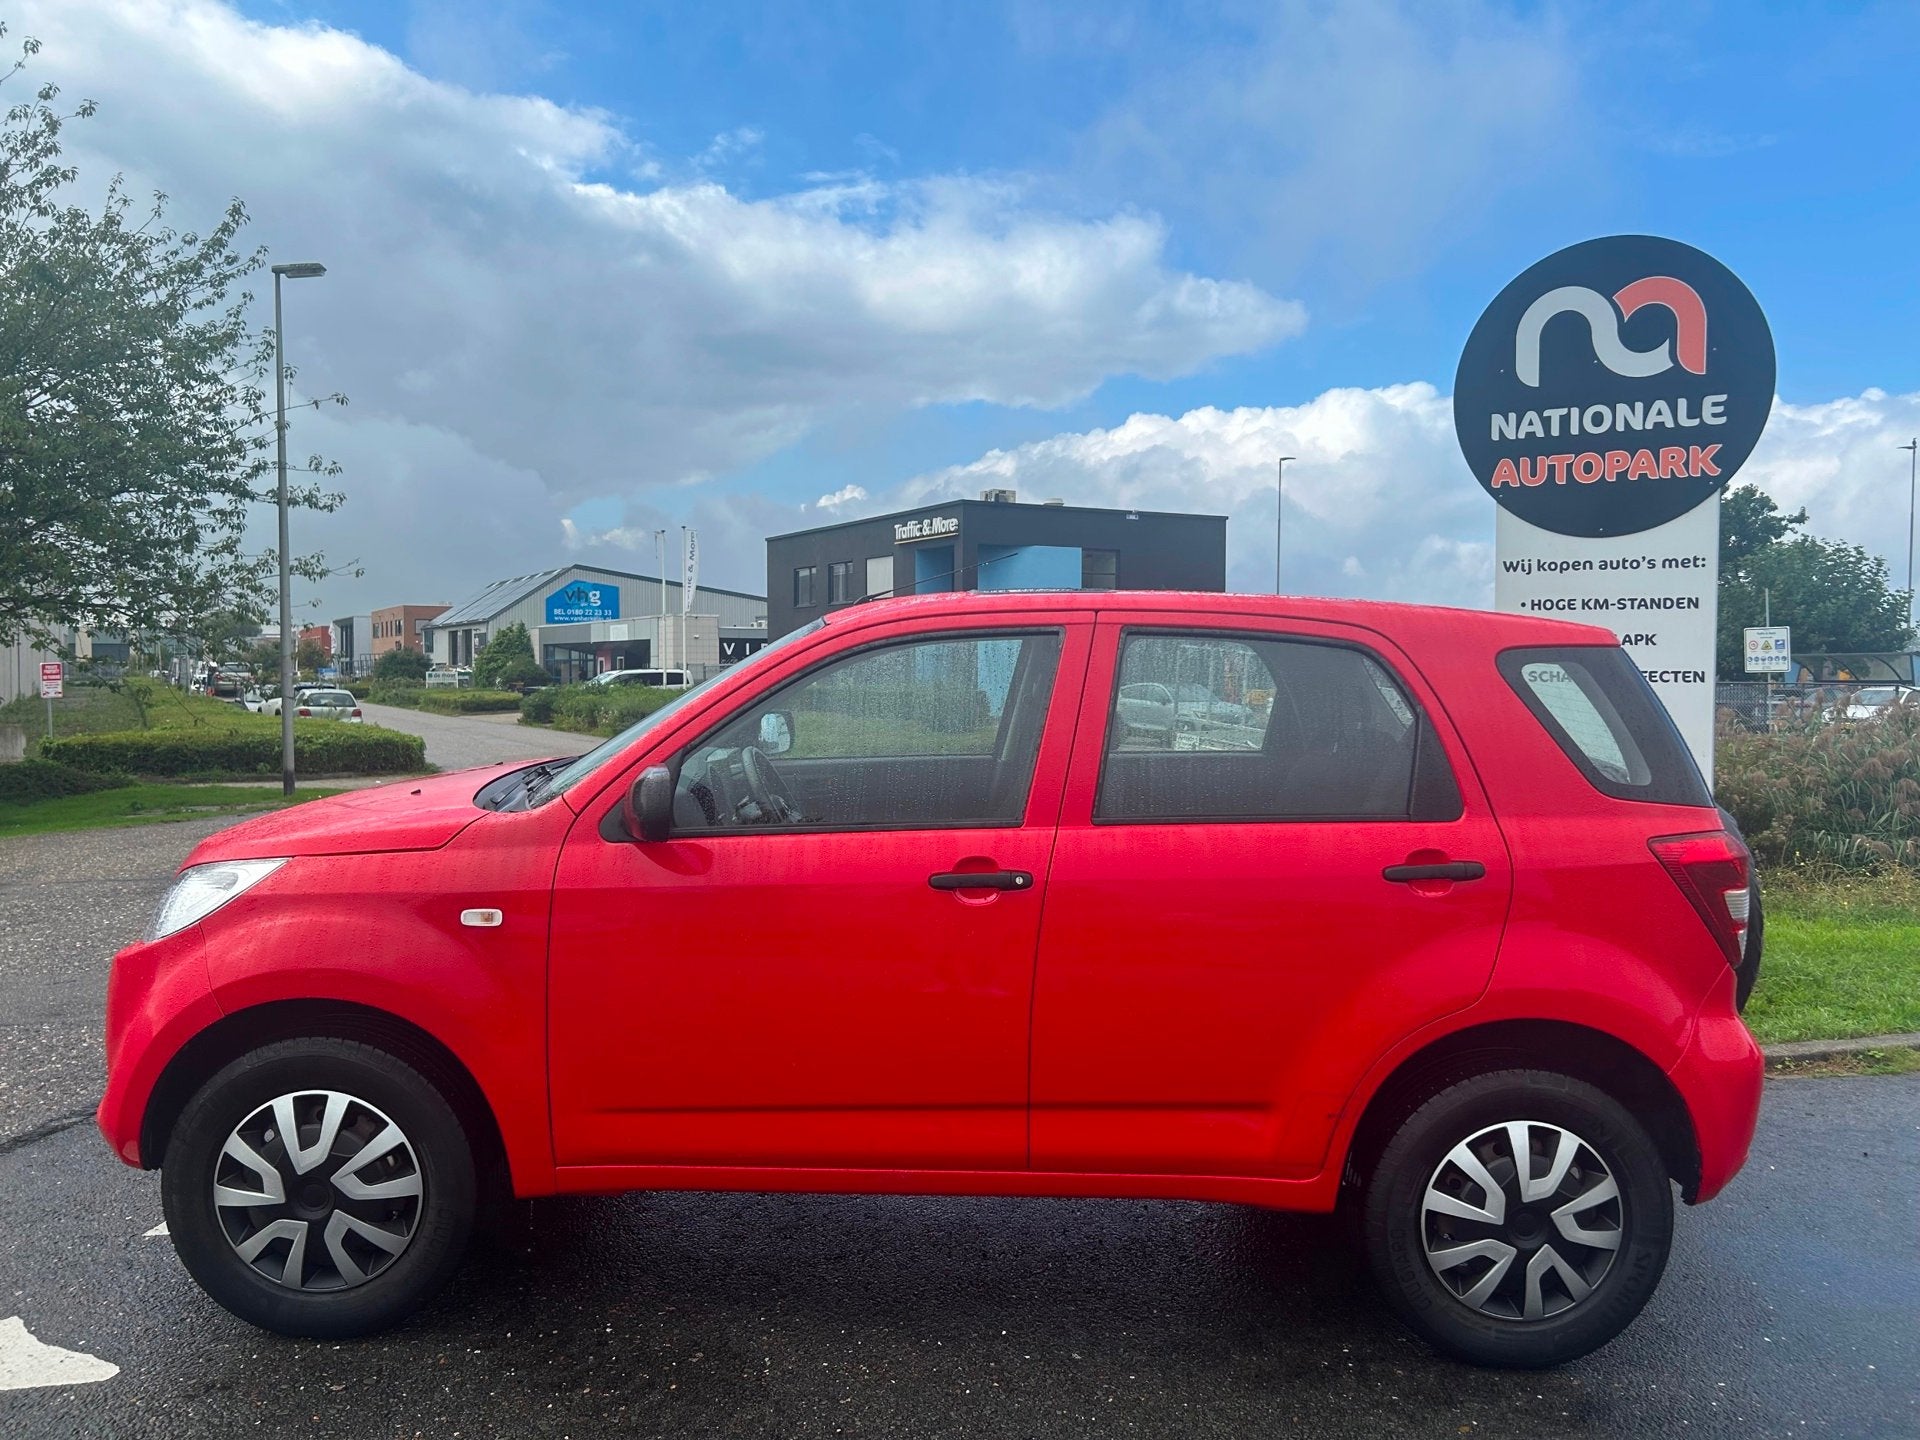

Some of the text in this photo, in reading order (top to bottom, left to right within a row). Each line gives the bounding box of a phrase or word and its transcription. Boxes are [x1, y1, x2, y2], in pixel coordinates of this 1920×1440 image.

[1490, 394, 1728, 441] NATIONALE
[1491, 444, 1723, 488] AUTOPARK
[894, 517, 958, 540] Traffic & More
[1503, 555, 1706, 575] Wij kopen auto's met:
[564, 586, 601, 606] vhg
[1530, 597, 1700, 611] HOGE KM-STANDEN
[1621, 633, 1657, 646] APK
[1528, 670, 1706, 683] SCHA ECTEN
